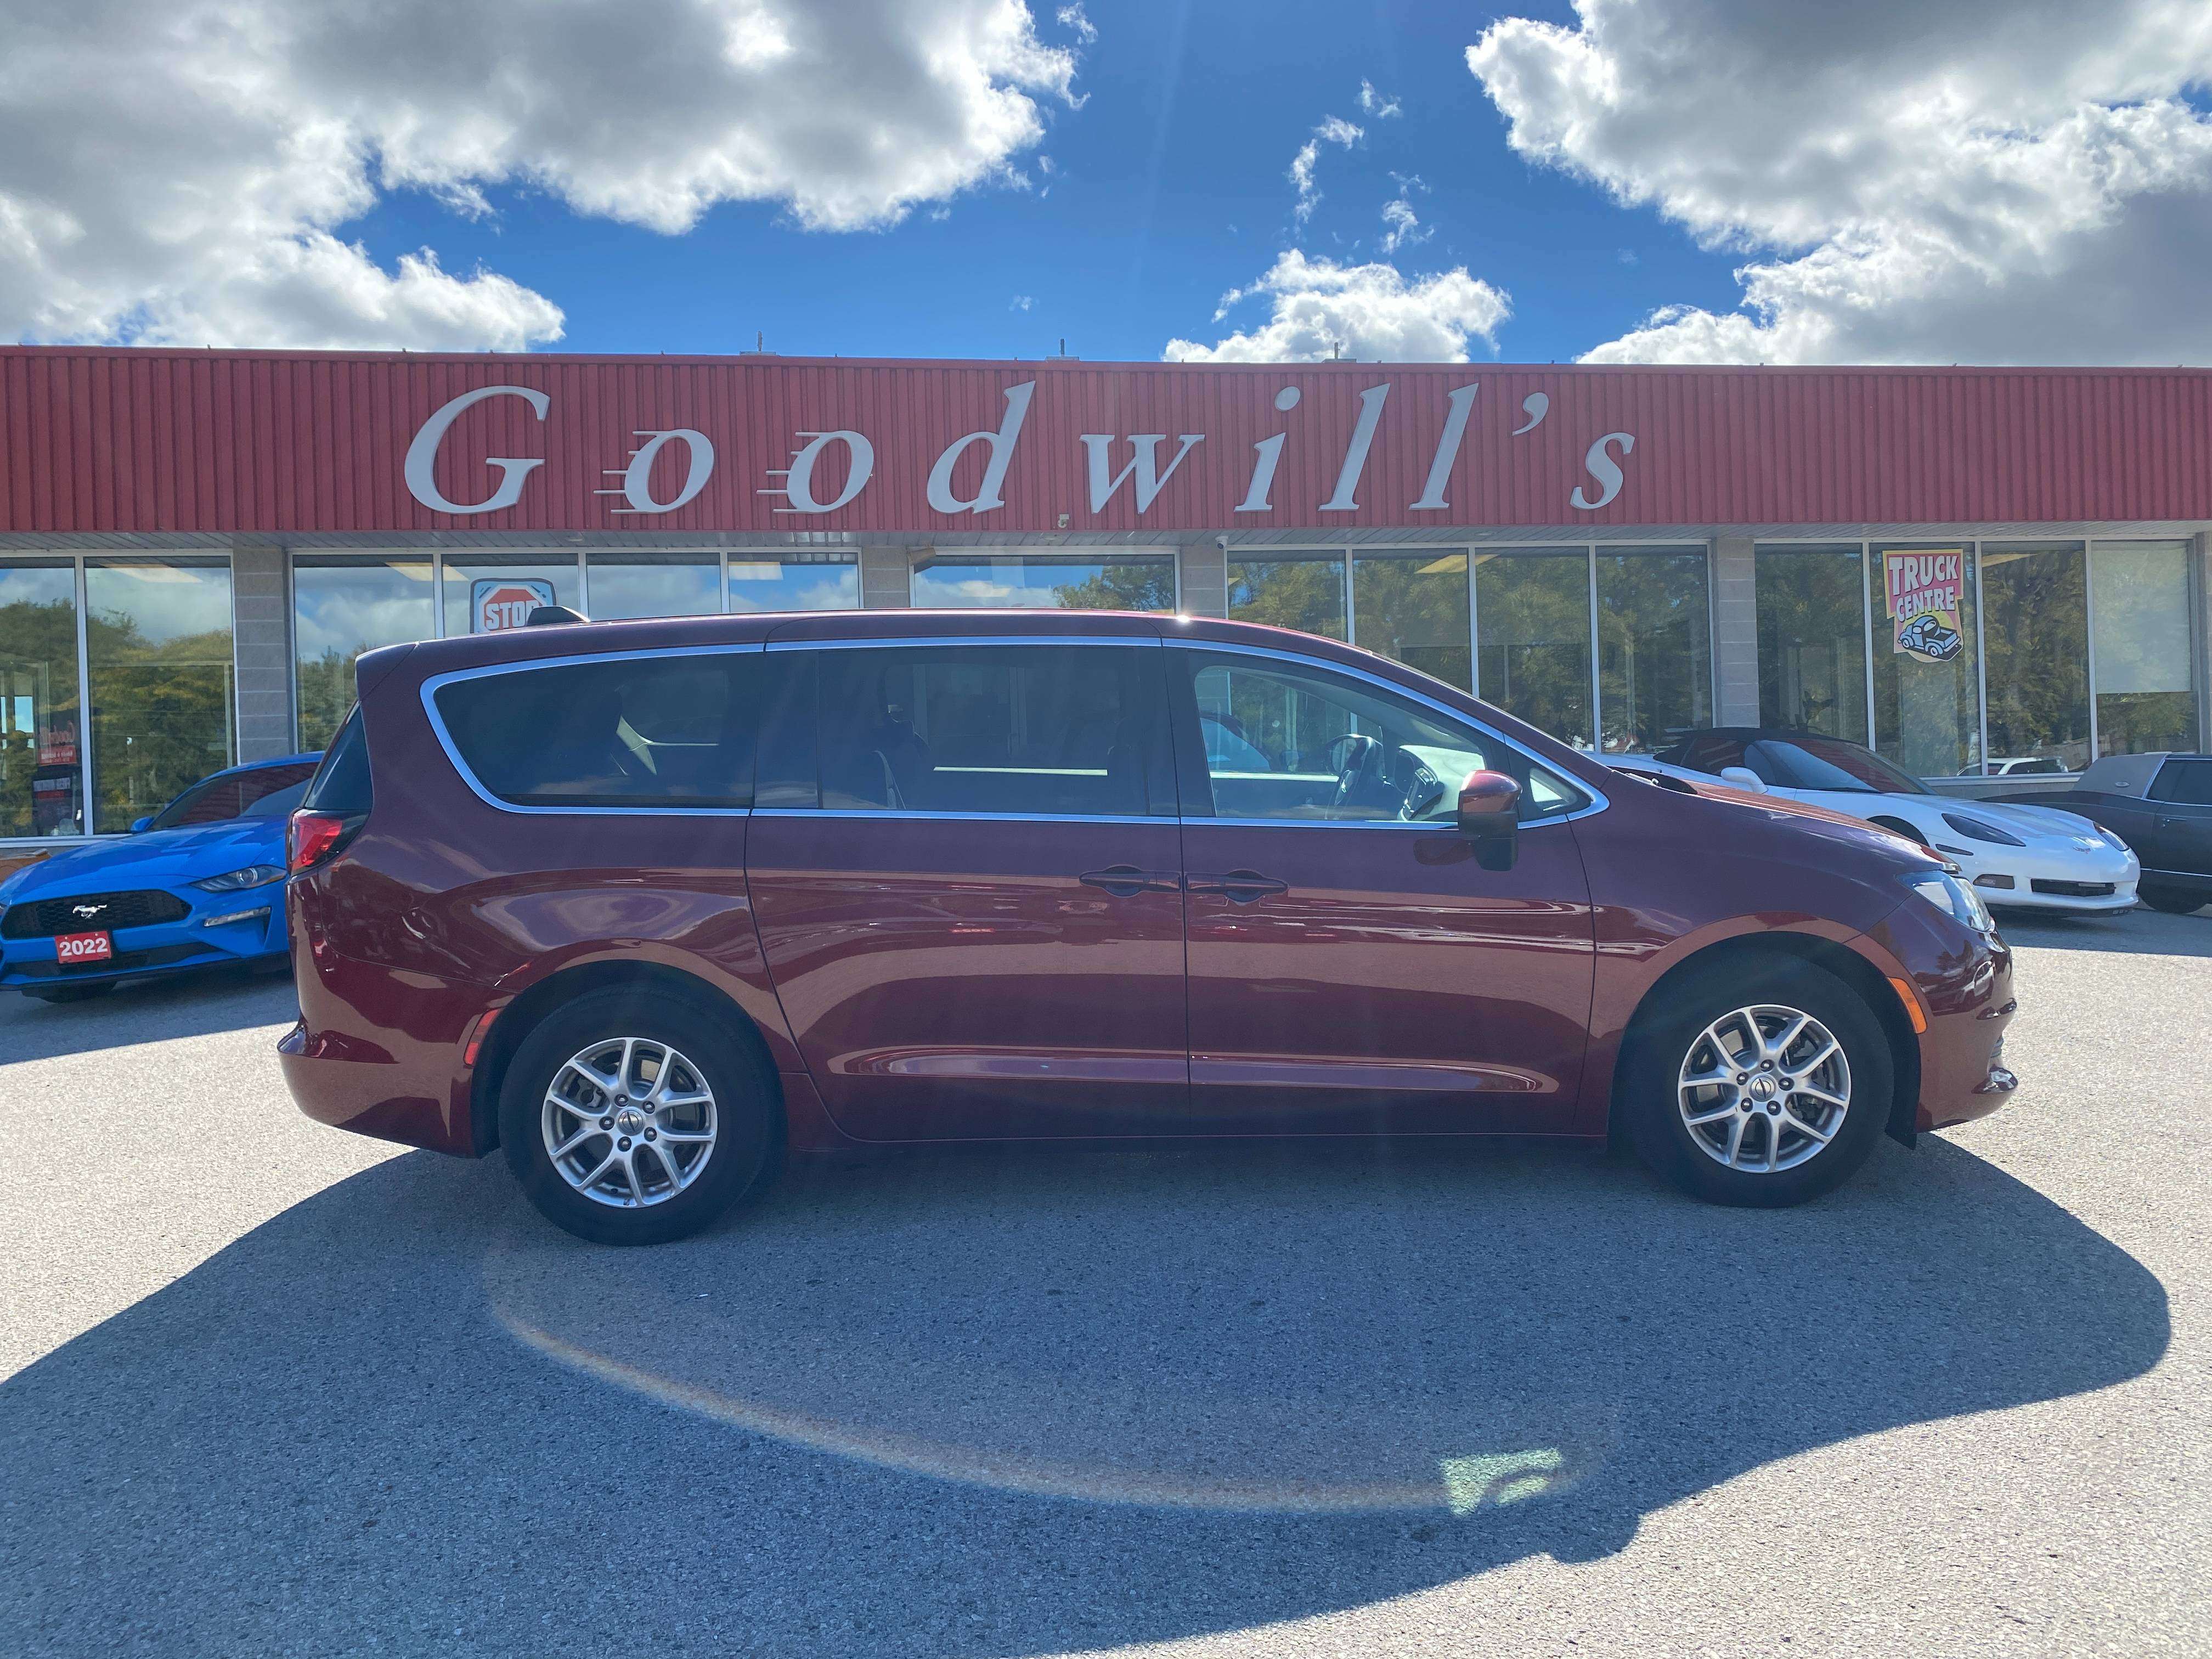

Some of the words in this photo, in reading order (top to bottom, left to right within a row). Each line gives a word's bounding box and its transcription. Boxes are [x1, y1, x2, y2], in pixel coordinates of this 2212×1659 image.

[404, 380, 1635, 516] Goodwill's
[1888, 555, 1959, 596] TRUCK
[1896, 585, 1955, 623] CENTRE
[59, 938, 108, 956] 2022
